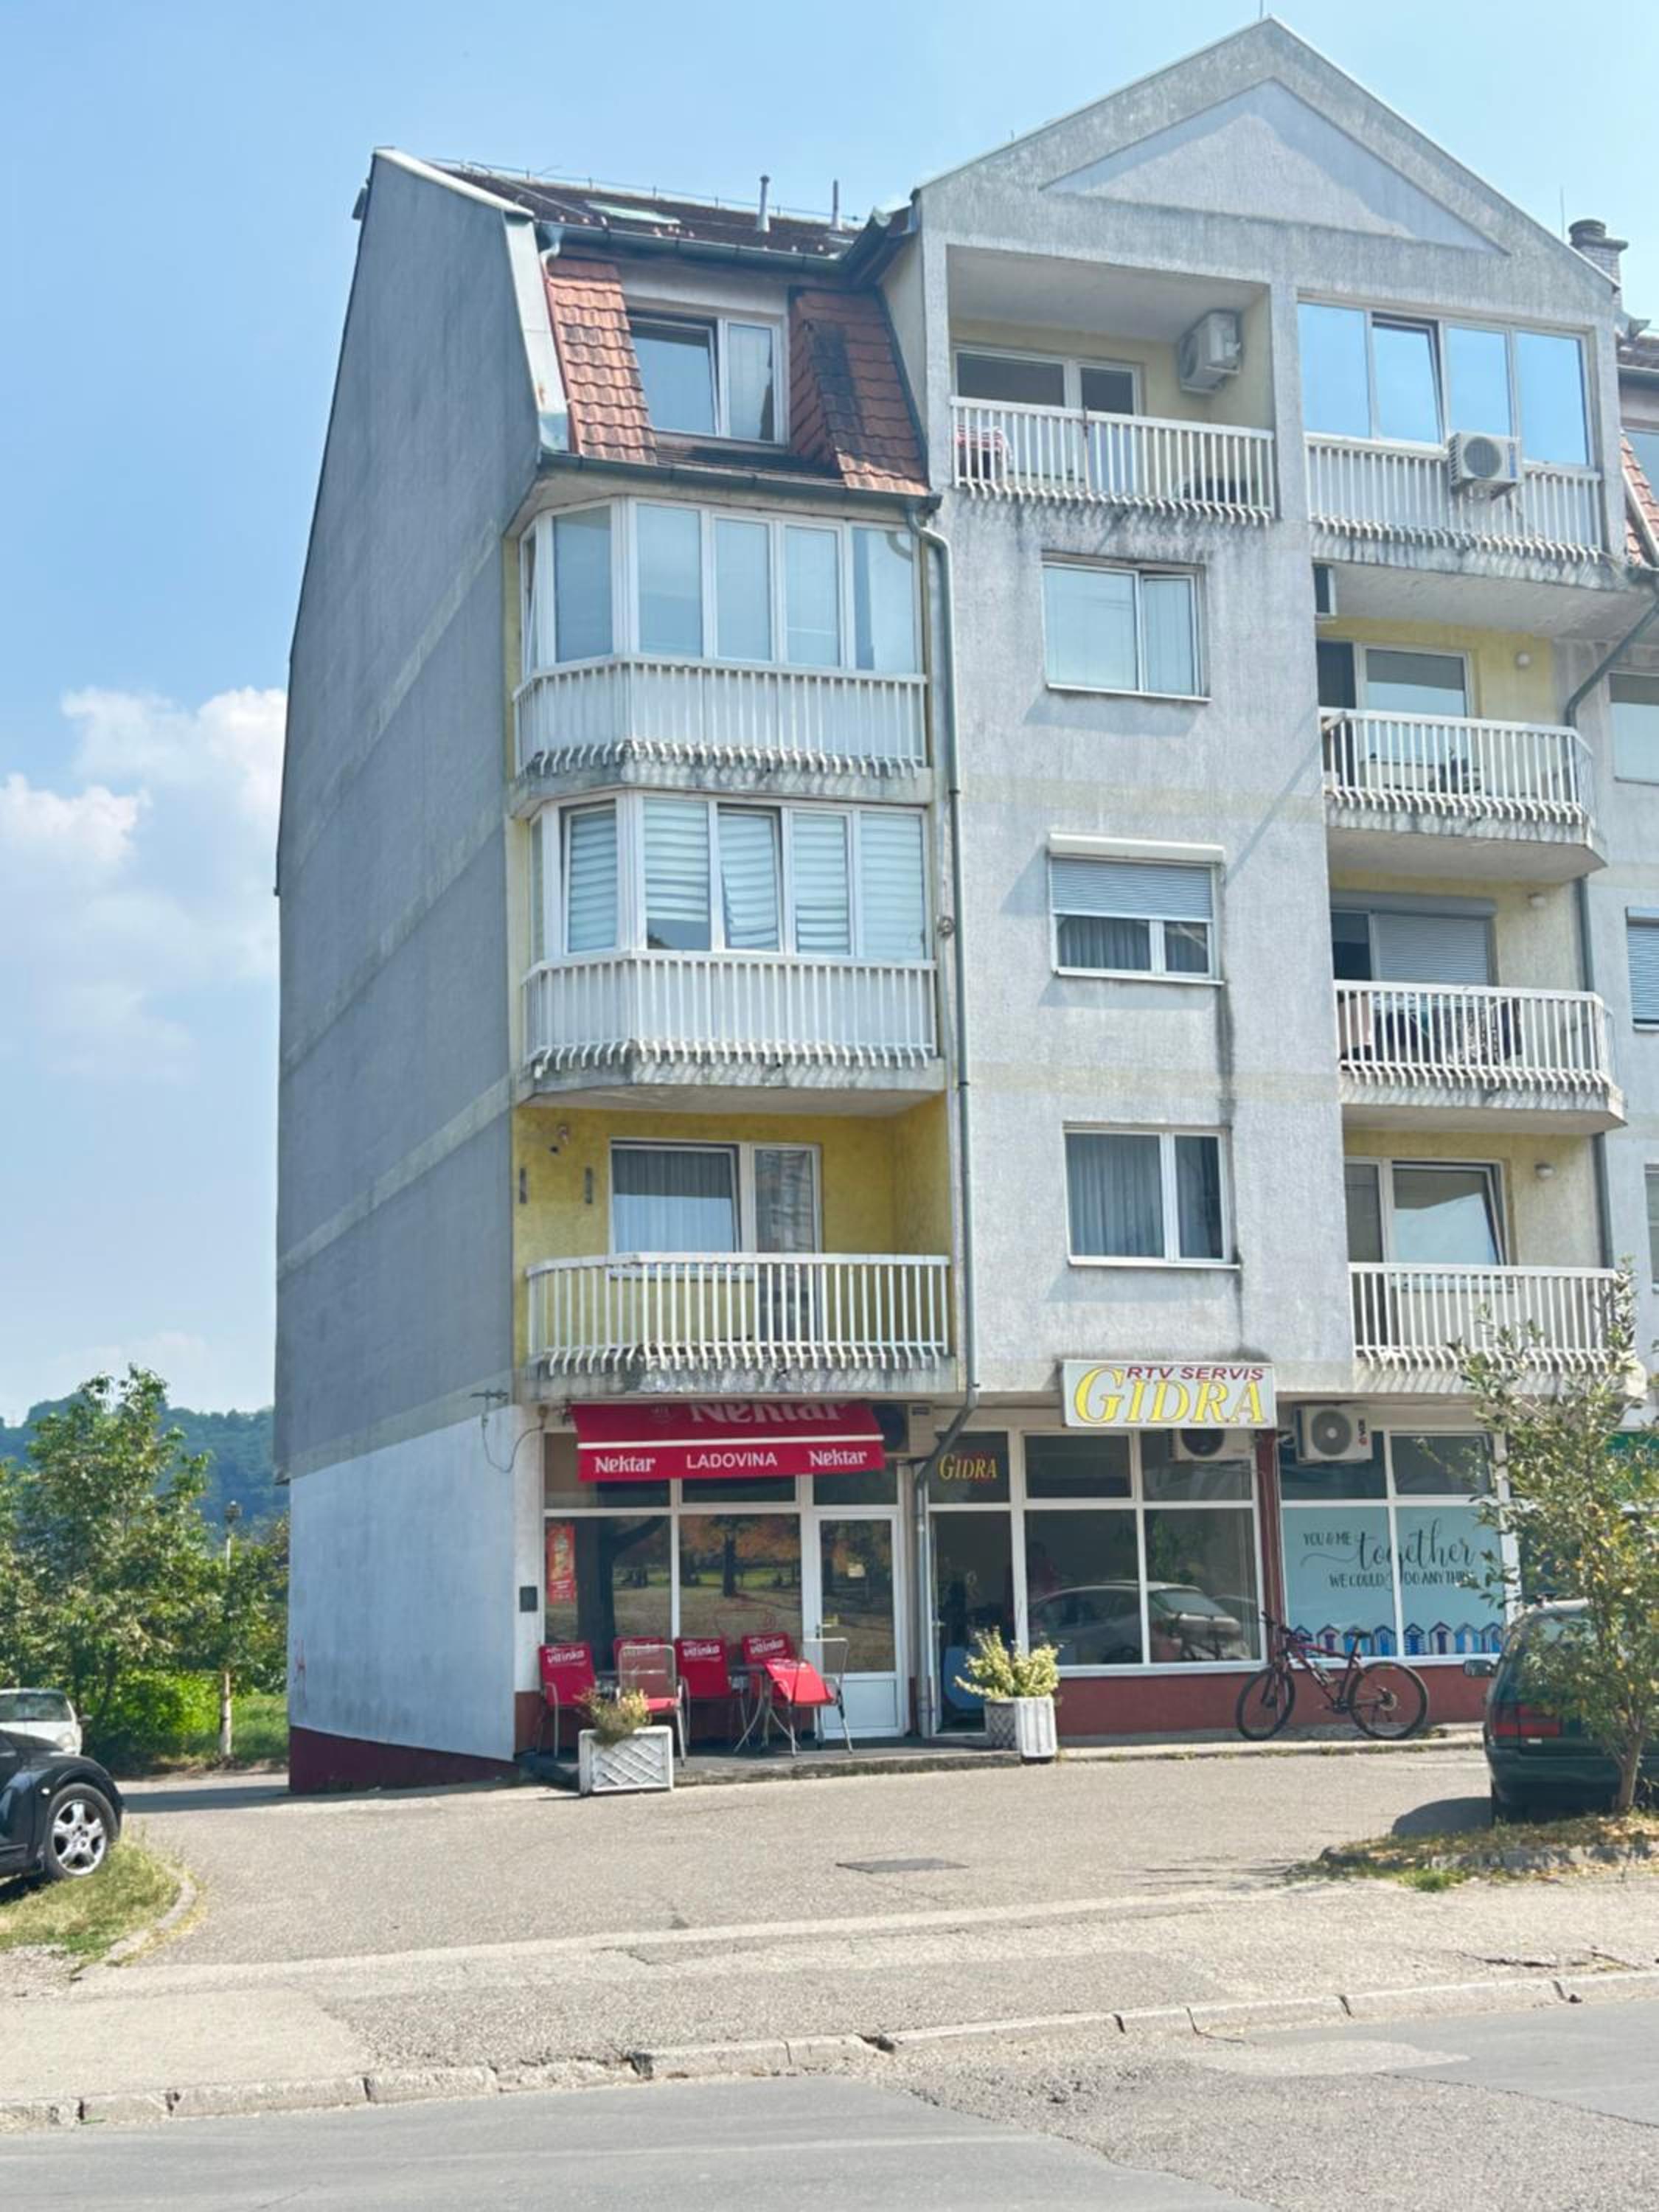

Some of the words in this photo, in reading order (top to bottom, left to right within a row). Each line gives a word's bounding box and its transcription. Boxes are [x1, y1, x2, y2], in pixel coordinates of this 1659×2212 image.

[1127, 1366, 1174, 1380] RTV
[1180, 1367, 1265, 1381] SERVIS
[1074, 1366, 1269, 1424] GIDRA
[594, 1455, 656, 1474] Nektar
[686, 1451, 778, 1470] LADOVINA
[809, 1449, 868, 1467] Nektar
[939, 1453, 998, 1481] GIDRA
